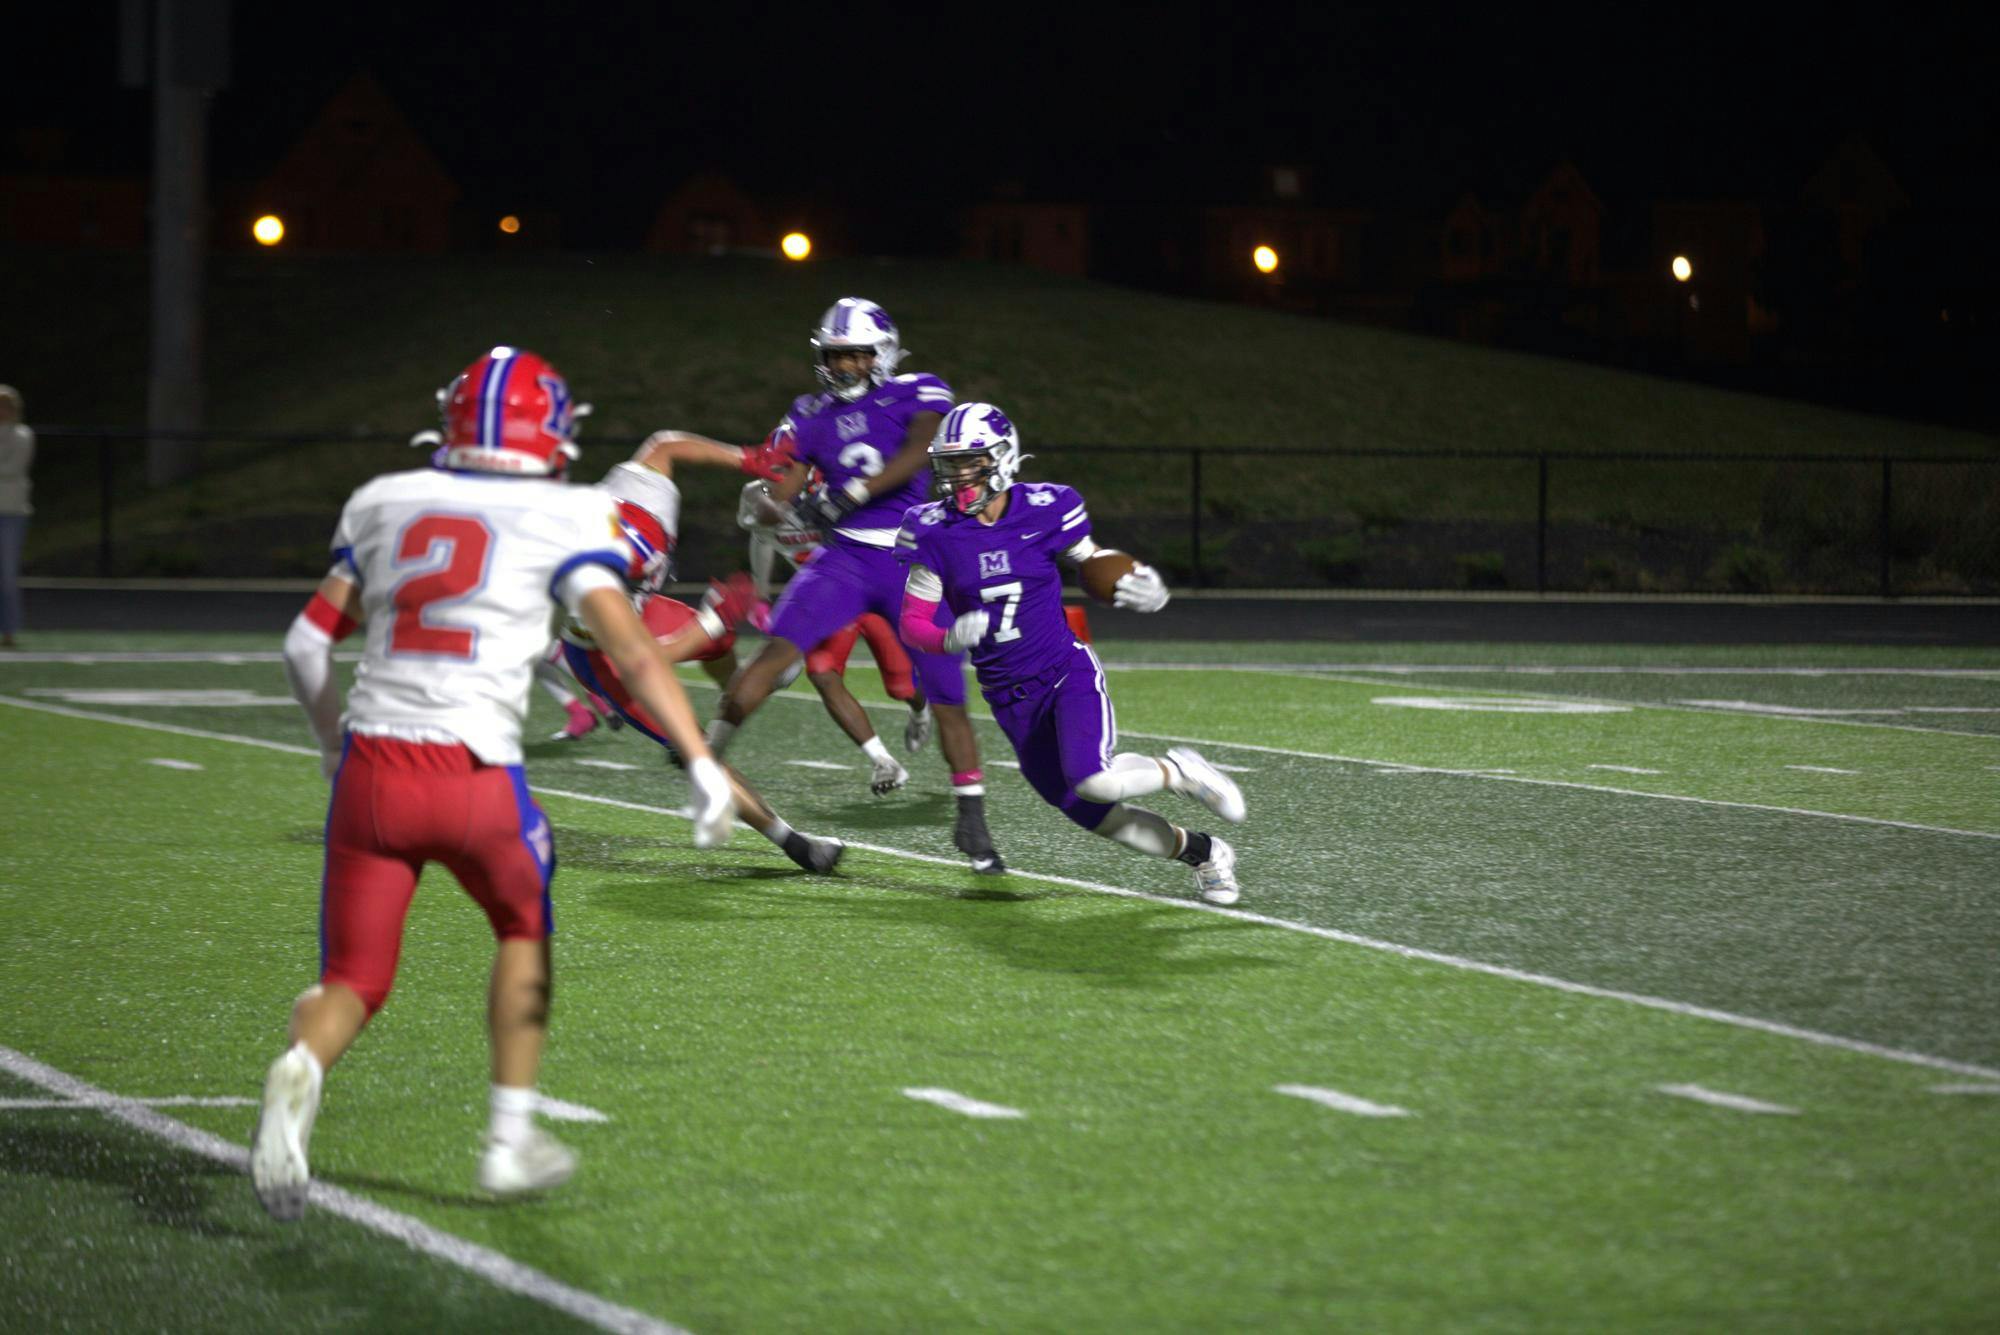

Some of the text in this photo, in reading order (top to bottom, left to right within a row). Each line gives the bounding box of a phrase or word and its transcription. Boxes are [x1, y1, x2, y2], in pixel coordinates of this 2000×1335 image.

[385, 511, 497, 664] 2
[979, 550, 1011, 579] M
[980, 581, 1022, 643] 7
